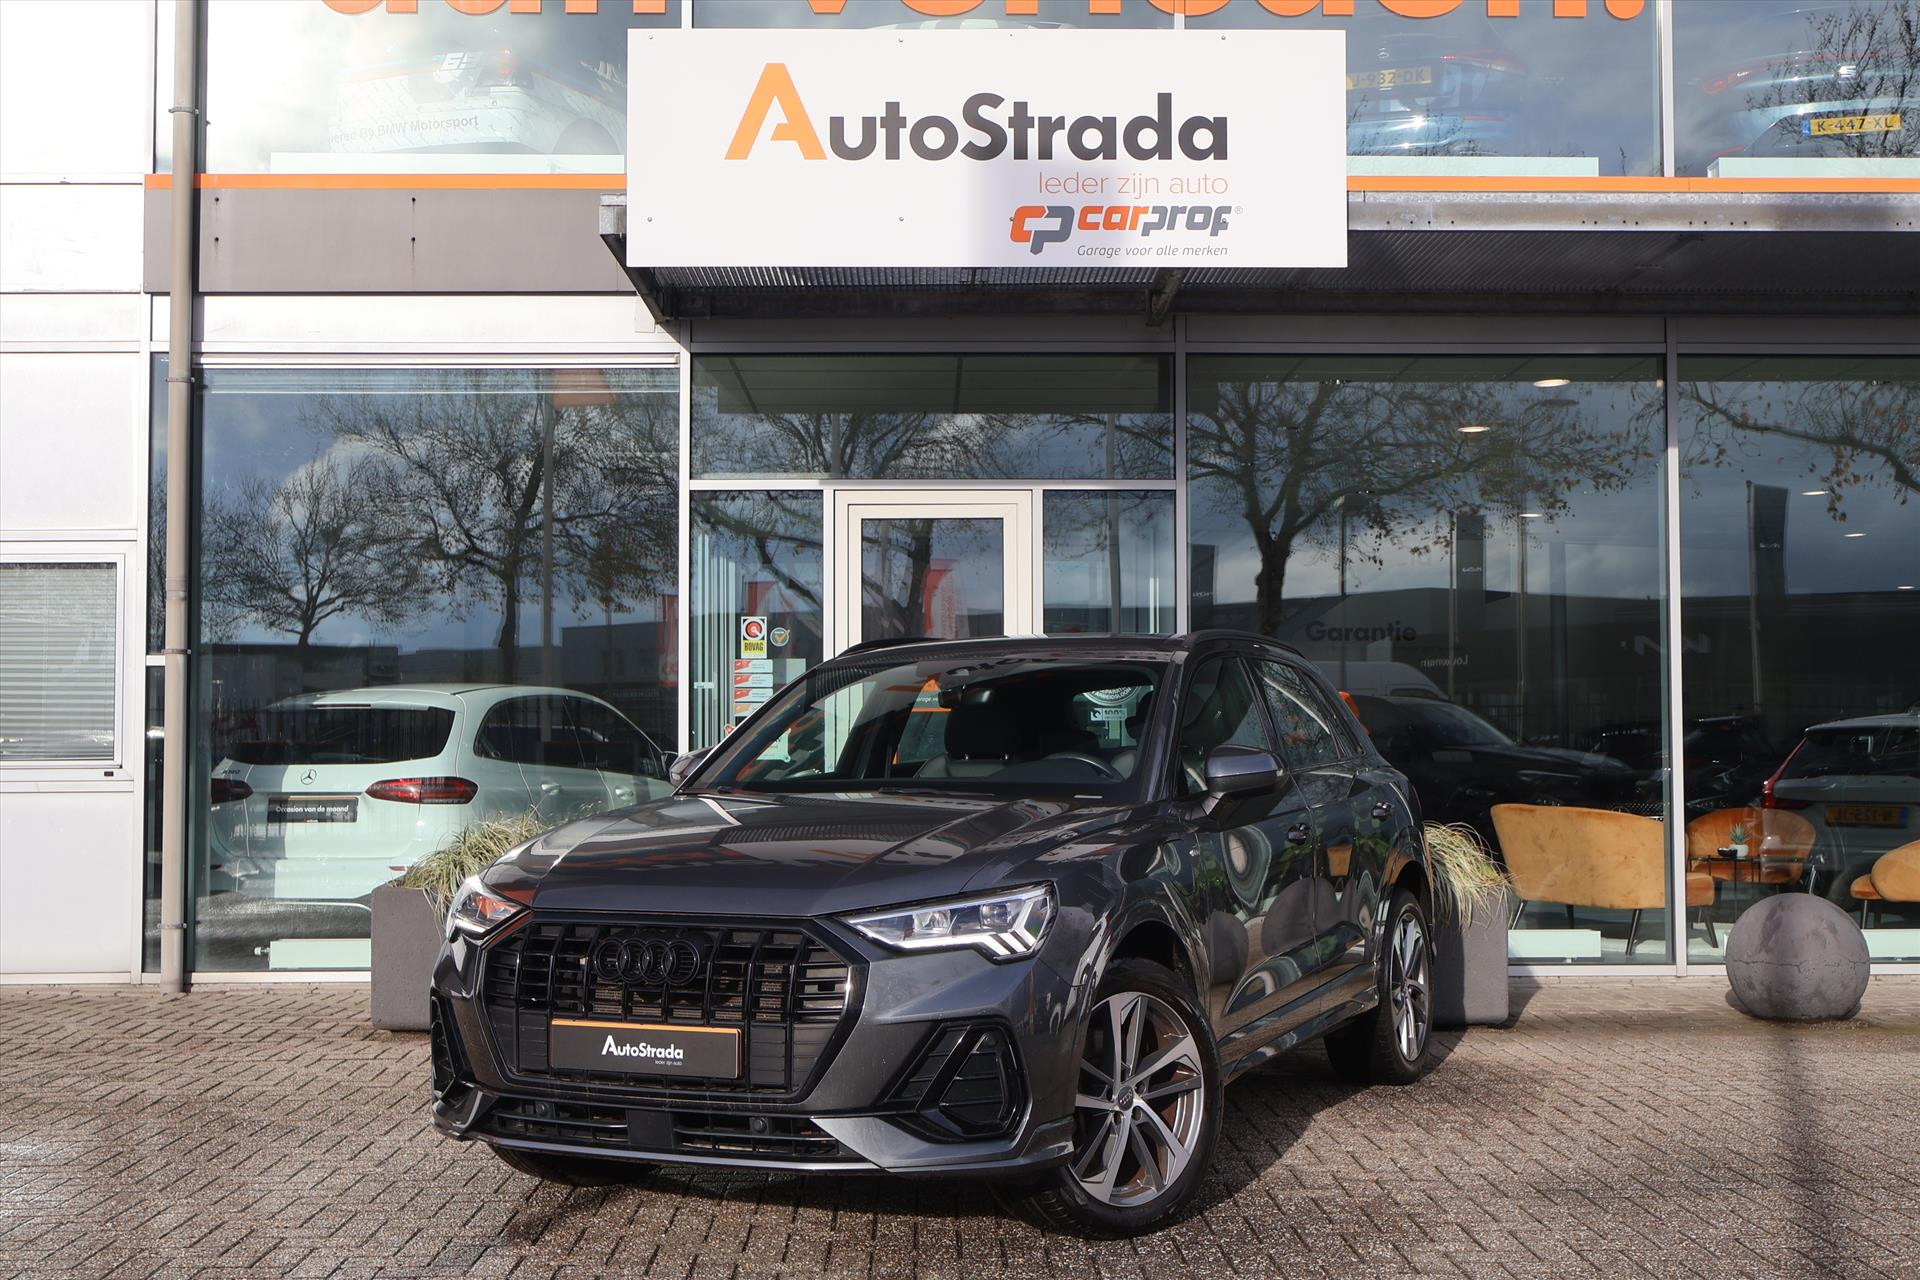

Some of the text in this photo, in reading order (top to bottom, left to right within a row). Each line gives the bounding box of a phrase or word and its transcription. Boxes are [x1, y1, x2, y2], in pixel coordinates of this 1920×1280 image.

[724, 63, 1228, 162] AutoStrada
[409, 115, 479, 132] Motorsport
[1816, 118, 1894, 133] K-447-XL
[1039, 171, 1228, 200] Ieder zijn auto
[1077, 245, 1228, 258] Garage voor alle merken
[1305, 620, 1417, 642] Garantie
[744, 642, 764, 652] BOVAG
[316, 805, 325, 813] de
[601, 1034, 684, 1059] AutoStrada
